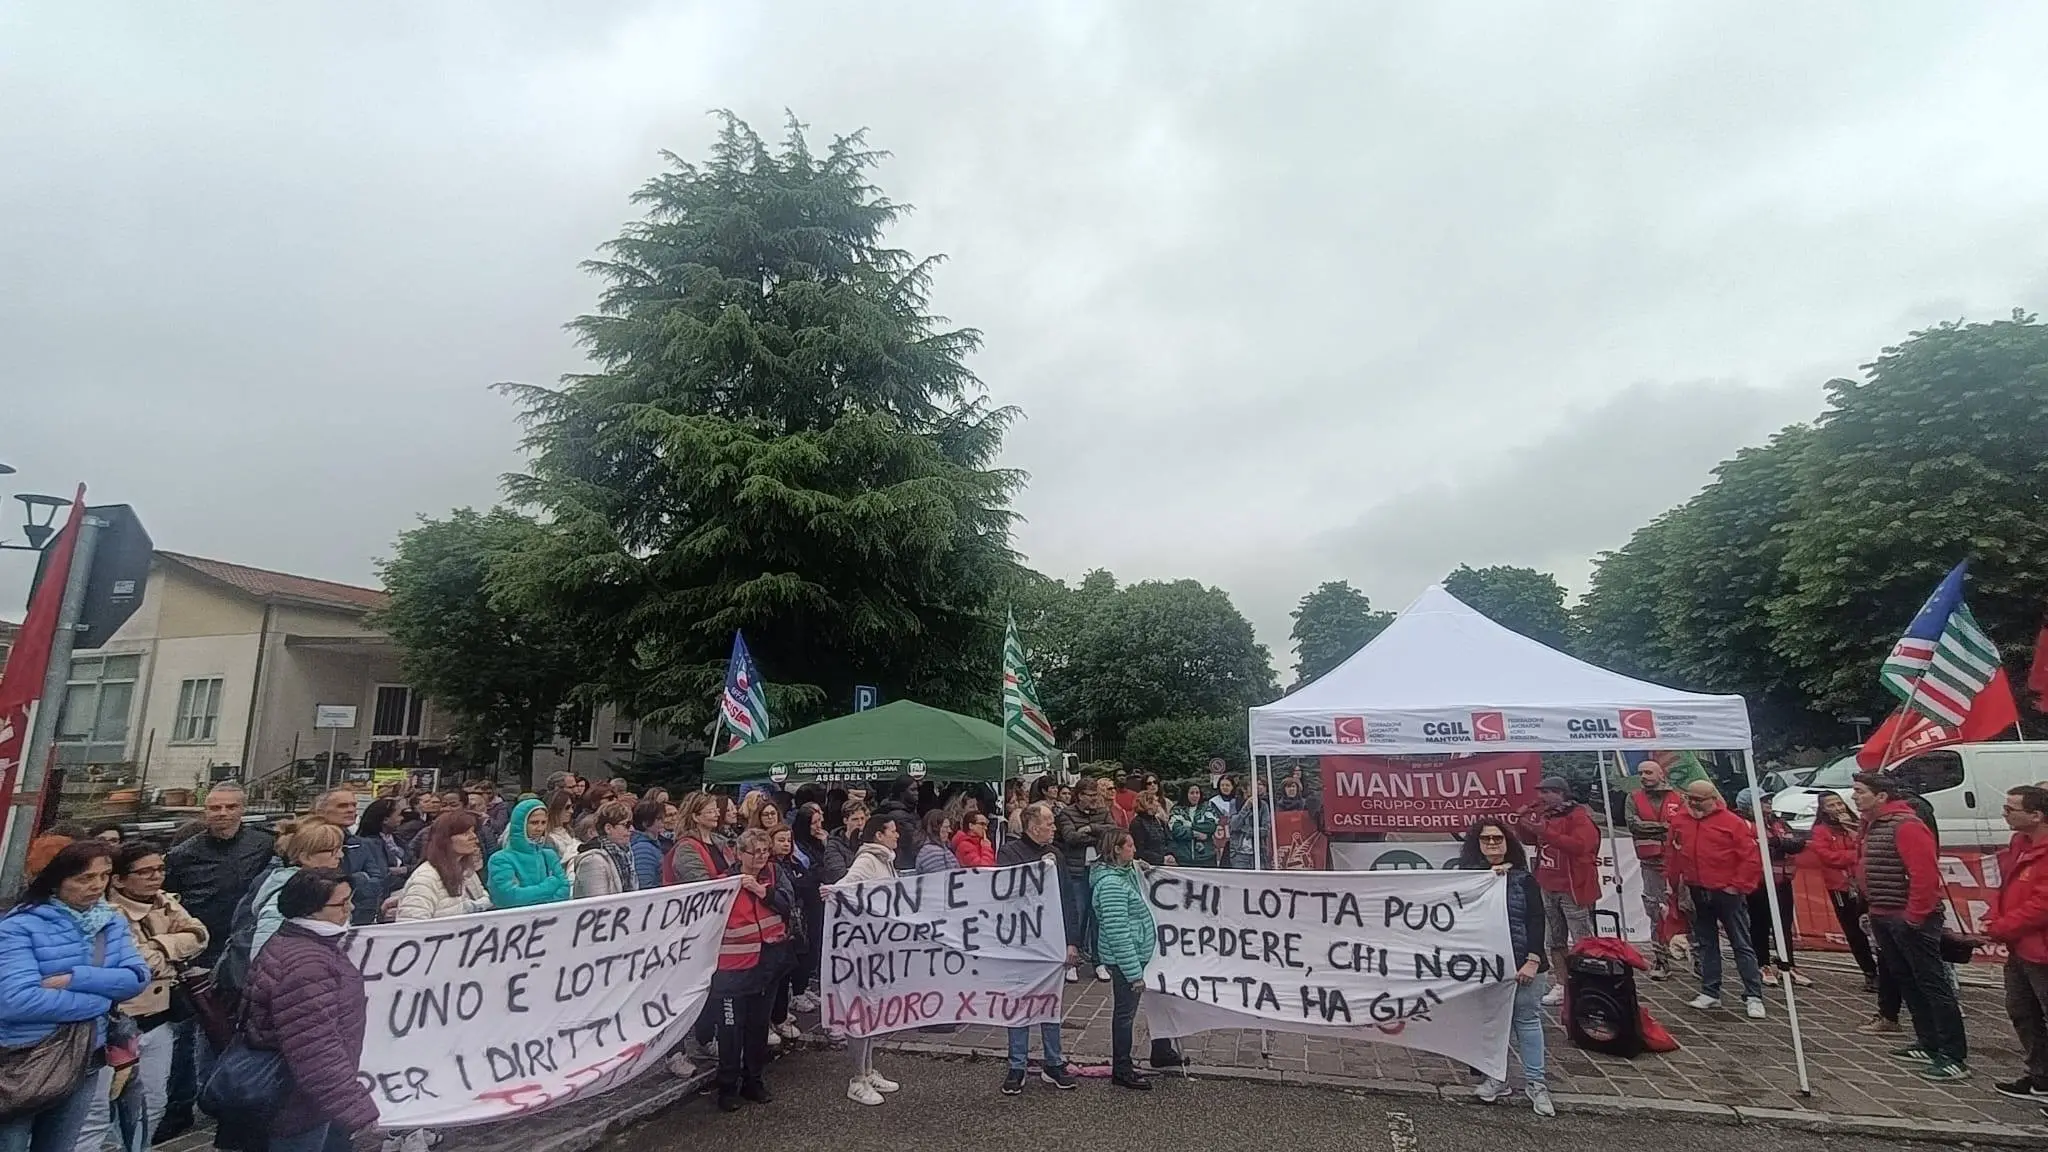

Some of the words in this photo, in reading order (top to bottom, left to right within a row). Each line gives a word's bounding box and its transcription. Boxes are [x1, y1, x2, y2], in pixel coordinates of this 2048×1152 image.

[861, 690, 871, 711] P
[1289, 725, 1332, 738] CGIL
[1423, 722, 1469, 736] CGIL
[1425, 735, 1471, 743] MANTOVA
[1567, 718, 1617, 732] CGIL
[1569, 731, 1618, 739] MANTOVA
[816, 774, 840, 782] ASSE
[844, 773, 862, 781] DEL
[1335, 769, 1527, 798] MANTUA.IT
[1361, 799, 1425, 810] GRUPPO
[1430, 798, 1511, 810] ITALPIZZA
[1333, 813, 1459, 827] CASTELBELFORTE
[833, 876, 925, 918] NON
[991, 861, 1047, 901] UN
[1602, 876, 1623, 885] PO
[1150, 879, 1219, 915] CHI
[1243, 887, 1364, 927] LOTTA
[360, 915, 558, 981] LOTTARE
[571, 903, 630, 948] PER
[640, 902, 654, 931] I
[832, 919, 946, 949] FAVORE
[996, 905, 1043, 946] UN
[831, 947, 979, 989] DIRITTO:
[1158, 924, 1313, 978] PERDERE,
[1328, 941, 1388, 976] CHI
[1415, 950, 1504, 984] NON
[388, 981, 484, 1038] UNO
[554, 935, 699, 1002] LOTTARE
[1157, 972, 1281, 1011] LOTTA
[1302, 985, 1351, 1023] HA
[827, 991, 944, 1035] LAVORO
[955, 991, 978, 1021] X
[358, 1065, 438, 1104] PER
[456, 1054, 472, 1091] I
[485, 1013, 627, 1083] DIRITTI
[642, 993, 678, 1028] DI
